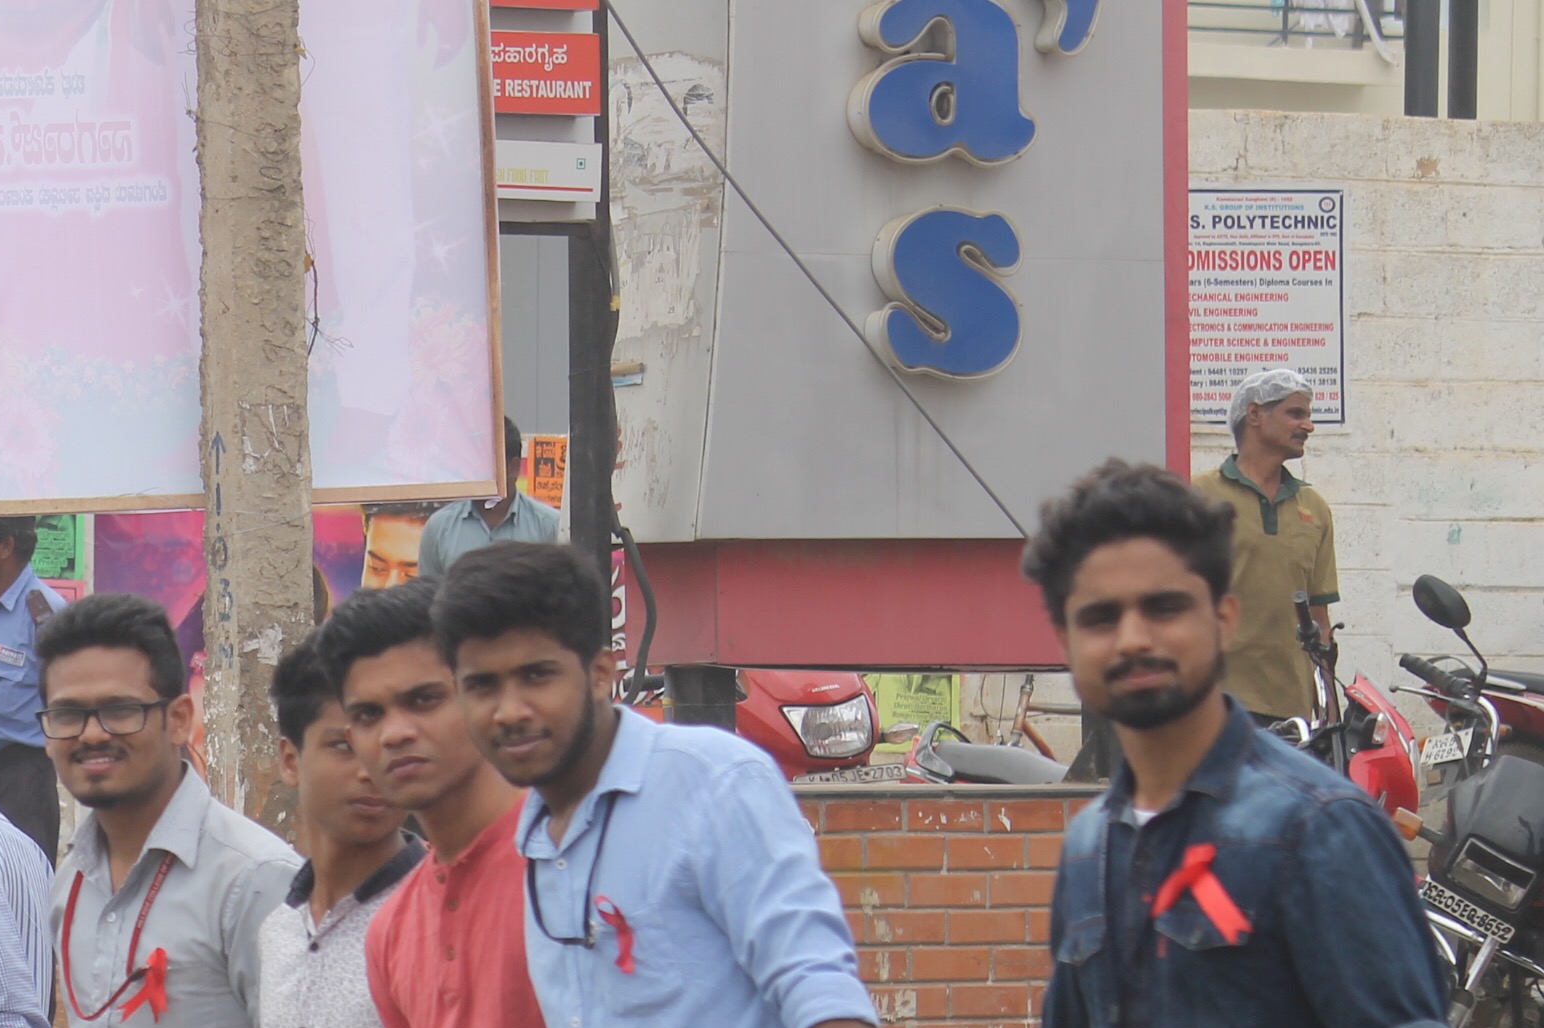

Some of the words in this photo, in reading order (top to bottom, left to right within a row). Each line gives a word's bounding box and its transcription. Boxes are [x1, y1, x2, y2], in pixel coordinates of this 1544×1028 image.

[505, 79, 592, 99] RESTAURANT
[1212, 215, 1338, 230] POLYTECHNIC
[1288, 250, 1337, 271] OPEN
[1203, 277, 1257, 288] (6-Semesters)
[1259, 278, 1290, 288] Diploma
[1291, 278, 1322, 287] Courses
[1325, 279, 1333, 287] In
[1234, 293, 1289, 302] ENGINEERING
[1203, 308, 1258, 317] ENGINEERING
[1227, 323, 1232, 332] &
[1233, 323, 1289, 332] COMMUNICATION
[1290, 323, 1334, 332] ENGINEERING
[1226, 338, 1261, 347] SCIENCE
[1263, 338, 1269, 347] &
[1271, 338, 1326, 347] ENGINEERING
[1234, 353, 1289, 362] ENGINEERING
